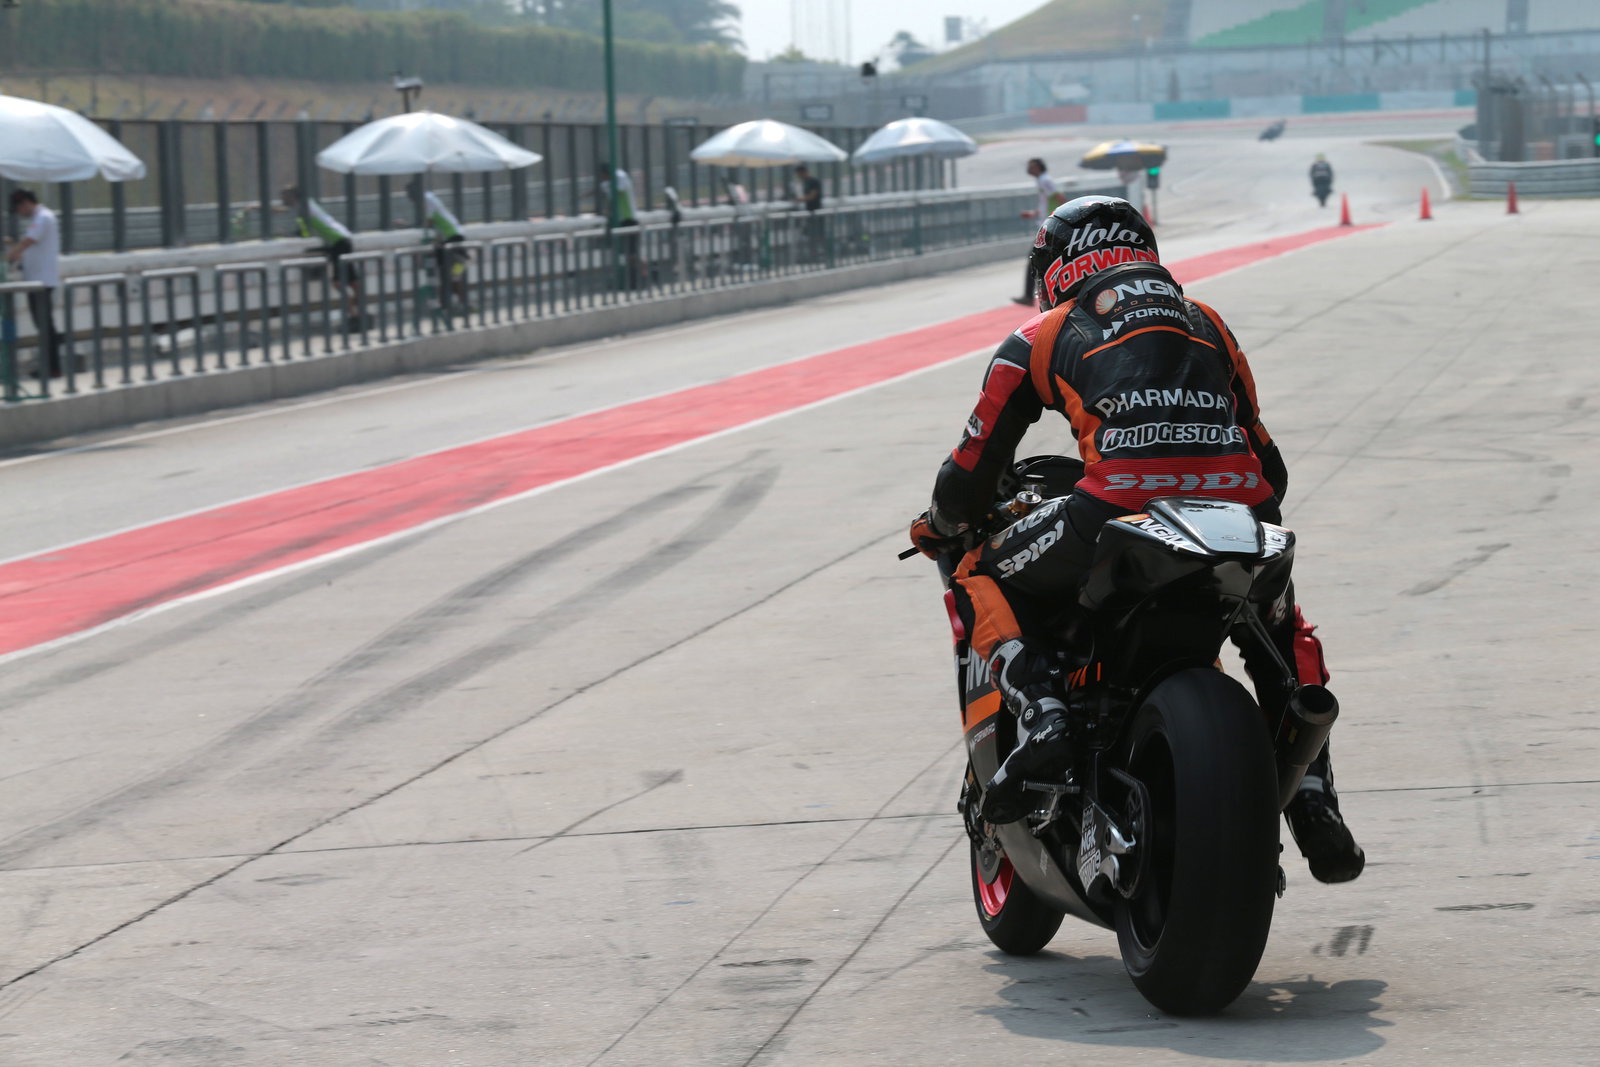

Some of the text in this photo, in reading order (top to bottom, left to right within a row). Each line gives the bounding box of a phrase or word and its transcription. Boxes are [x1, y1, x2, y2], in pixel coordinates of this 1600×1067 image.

[1064, 222, 1144, 256] Hola
[1114, 297, 1181, 313] MOBIL
[1100, 422, 1243, 452] BRIDGESTONE
[1104, 472, 1259, 491] SPIDI
[996, 520, 1065, 579] SPIDI
